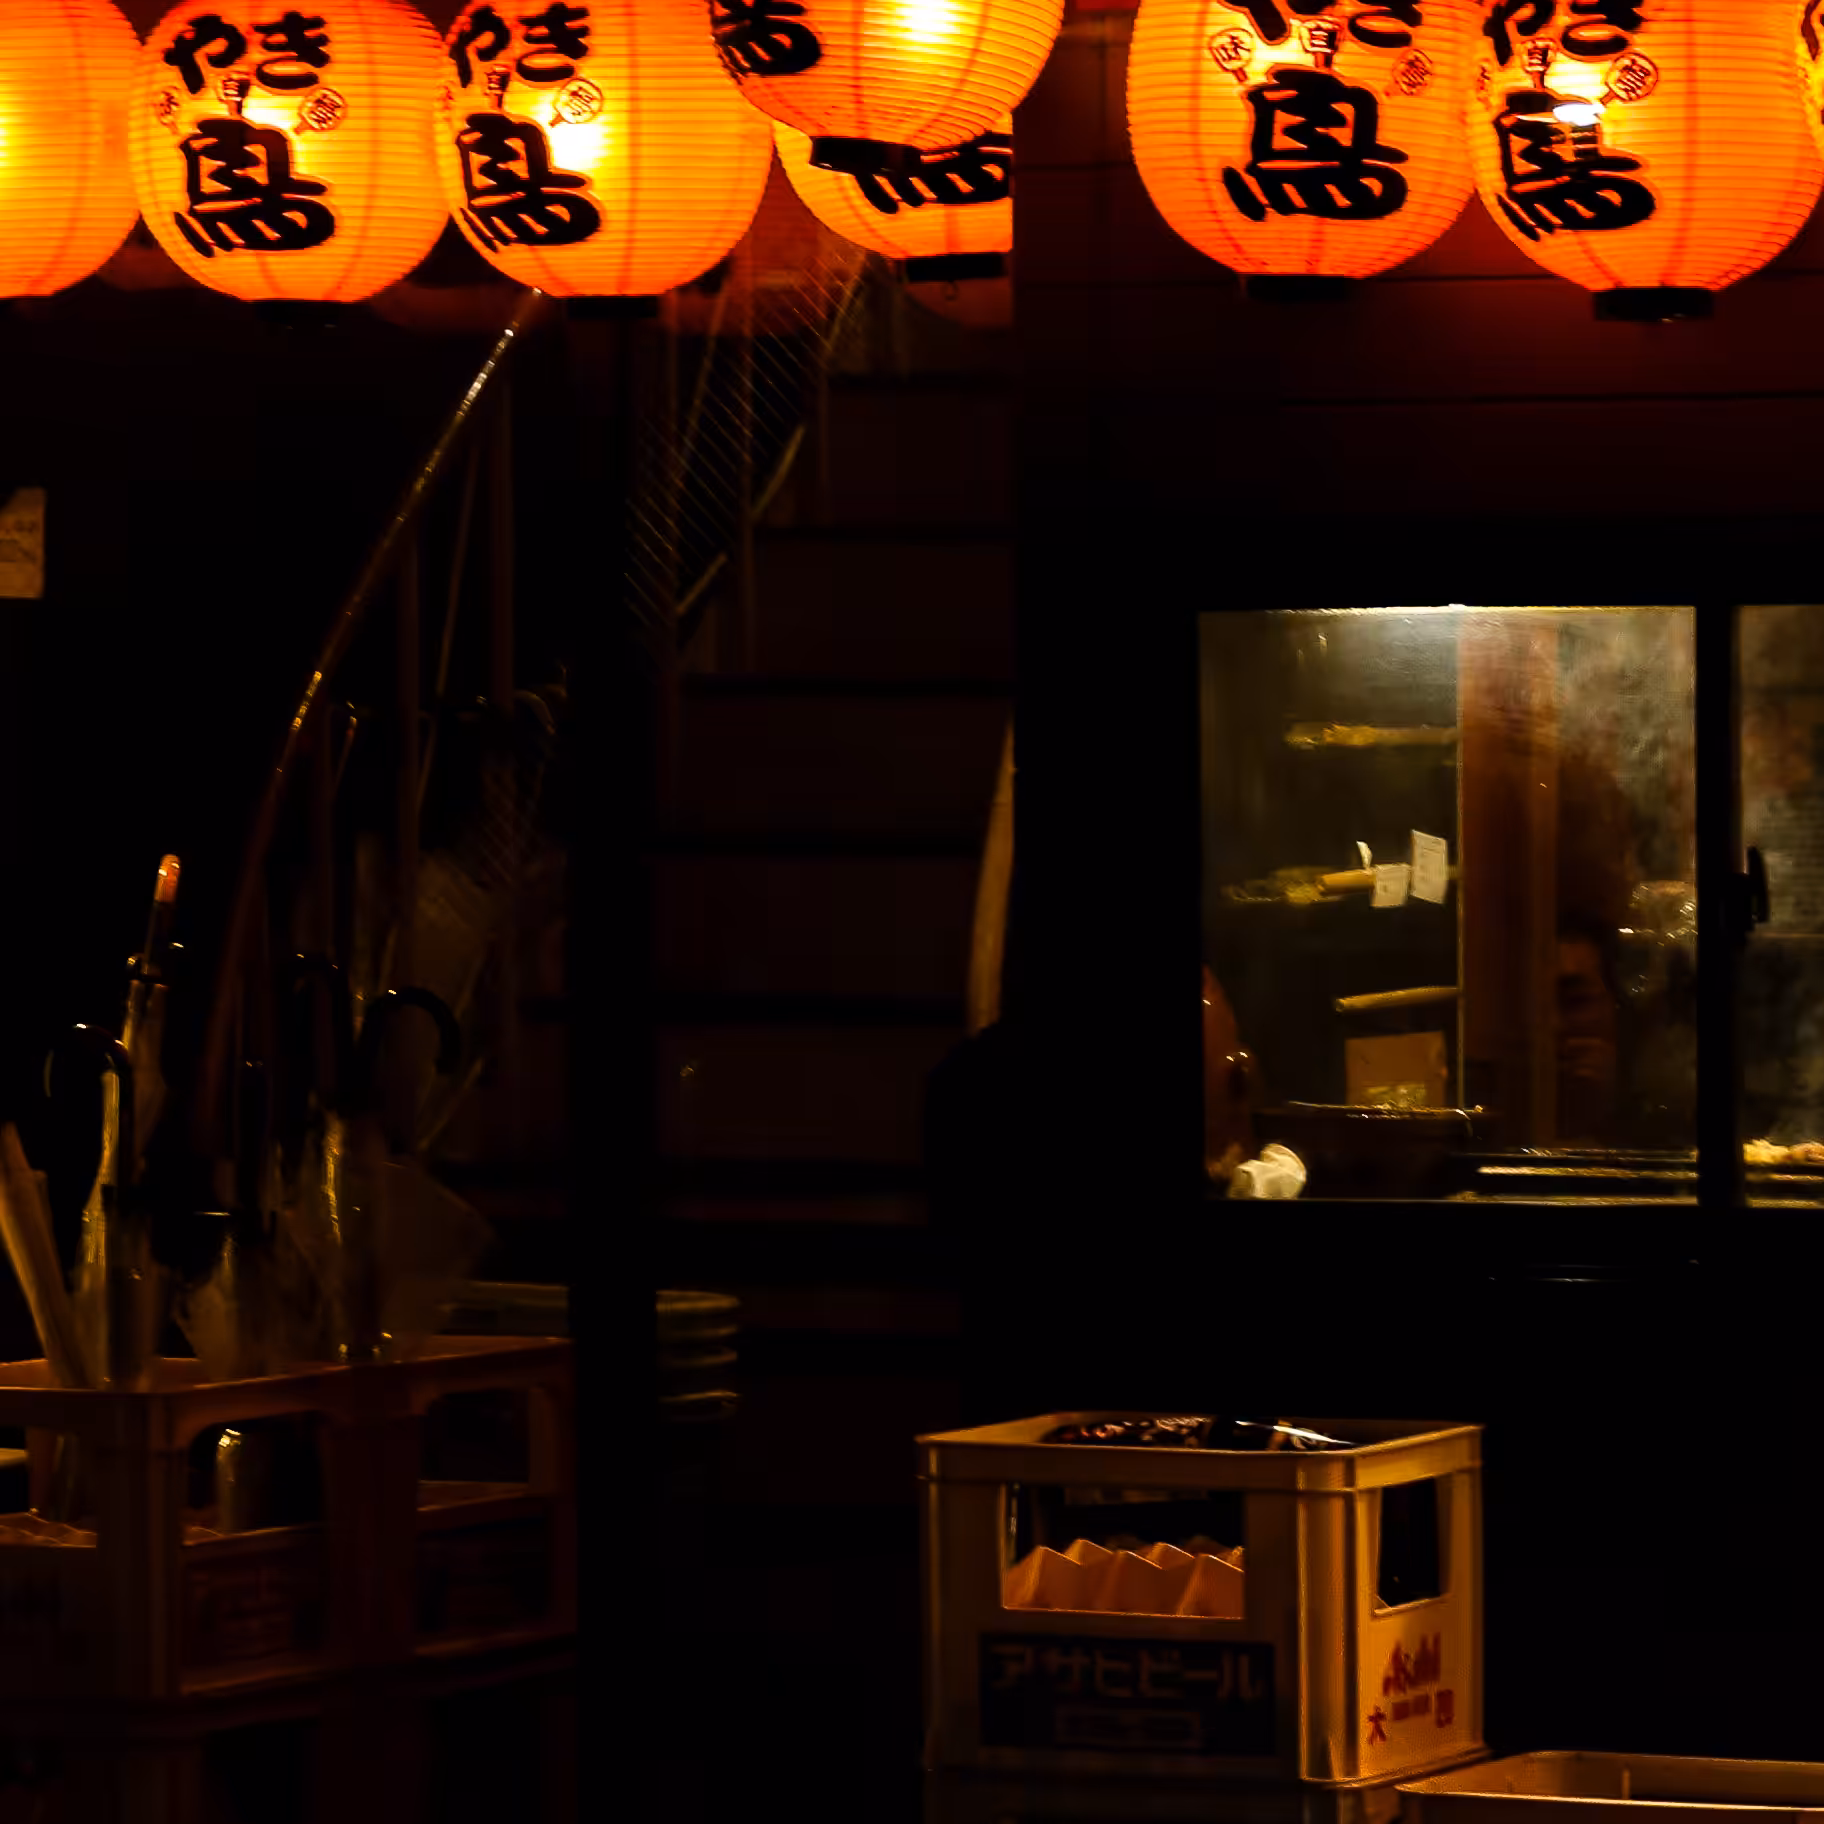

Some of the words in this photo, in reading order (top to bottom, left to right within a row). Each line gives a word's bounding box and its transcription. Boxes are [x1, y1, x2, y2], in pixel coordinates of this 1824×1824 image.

[988, 1642, 1264, 1702] アサヒビール
